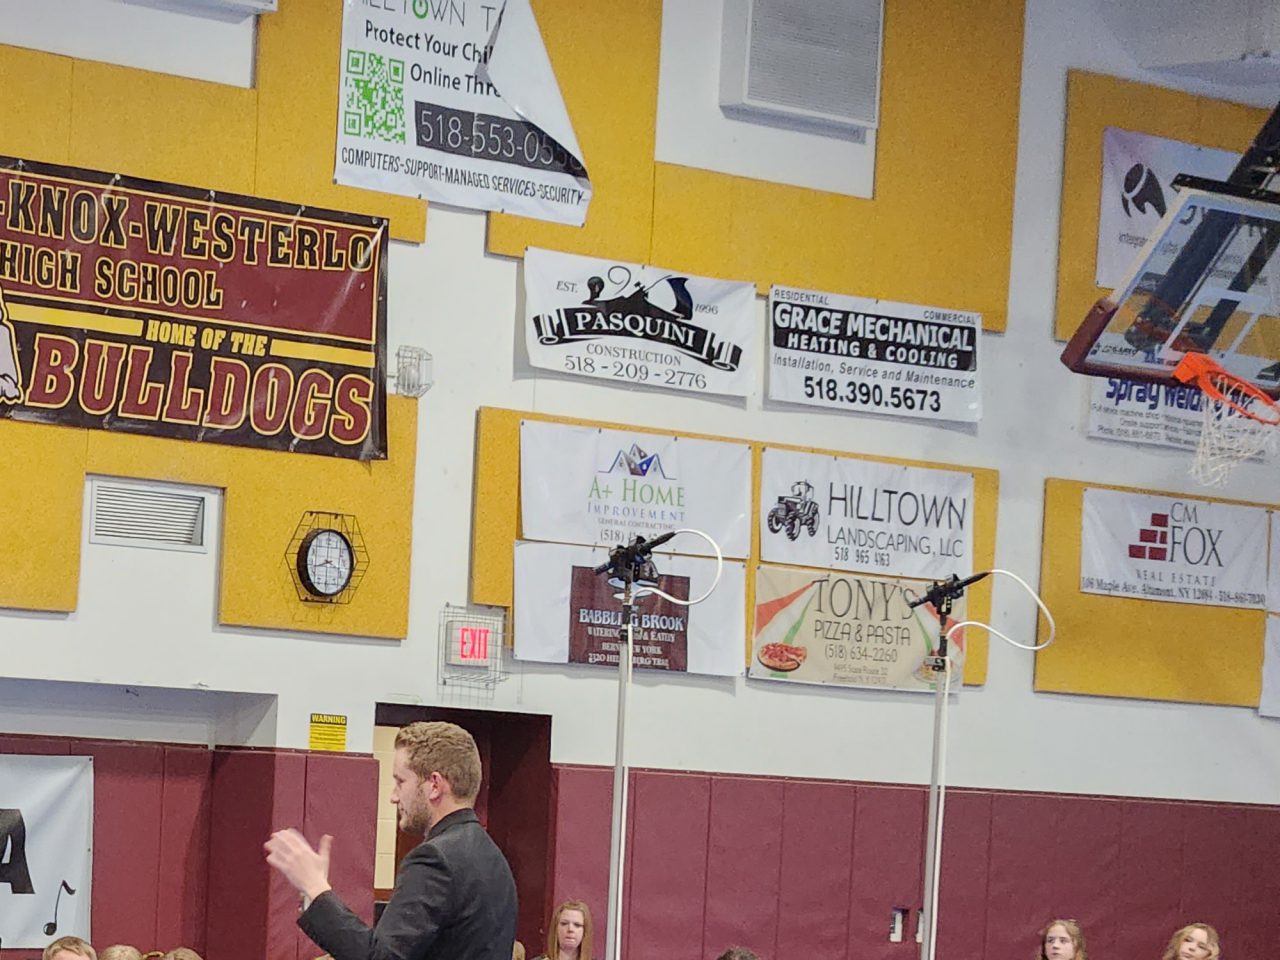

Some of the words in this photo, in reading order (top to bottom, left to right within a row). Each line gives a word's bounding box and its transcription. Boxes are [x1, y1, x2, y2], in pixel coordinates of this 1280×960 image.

[365, 19, 421, 51] Protect
[424, 33, 459, 58] Your
[462, 42, 495, 65] Chil
[410, 63, 461, 91] Online
[420, 110, 583, 171] 518-553-05
[95, 254, 225, 311] SCHOOL
[774, 288, 830, 306] RESIDENTIAL
[694, 302, 719, 316] 1996
[923, 309, 976, 325] COMMERCIAL
[144, 317, 199, 349] HOME
[201, 325, 226, 352] OF
[229, 329, 270, 356] THE
[573, 310, 697, 349] PASQUINI
[774, 302, 842, 335] GRACE
[846, 313, 973, 352] MECHANICAL
[586, 343, 682, 367] CONSTRUCTION
[787, 332, 861, 357] HEATING
[867, 343, 878, 359] &
[885, 346, 959, 369] COOLING
[773, 353, 834, 374] Installation,
[839, 361, 878, 379] Service
[881, 366, 902, 382] and
[905, 371, 976, 390] Maintenance
[24, 331, 377, 446] BULLDOGS
[804, 375, 942, 413] 518.390.5673
[588, 475, 613, 499] A+
[622, 478, 686, 507] HOME
[827, 482, 968, 531] HILLTOWN
[587, 501, 686, 522] IMPROVEMENT
[1170, 502, 1199, 524] CM
[600, 528, 625, 543] (518)
[826, 525, 937, 557] LANDSCAPING,
[939, 536, 964, 558] LLC
[1168, 525, 1225, 568] FOX
[834, 547, 849, 561] 518
[855, 549, 870, 564] 965
[874, 551, 891, 567] 4163
[1136, 568, 1163, 583] REAL
[1171, 571, 1218, 587] ESTATE
[813, 578, 915, 621] TONY'S
[579, 608, 639, 628] BABBLIG
[641, 614, 684, 632] BROOK
[814, 619, 852, 642] PIZZA
[854, 623, 863, 643] &
[866, 624, 911, 646] PASTA
[459, 627, 490, 661] EXIT
[642, 645, 663, 655] YORK
[824, 643, 848, 660] (518)
[850, 645, 898, 664] 634-2260
[311, 714, 346, 725] WARNING
